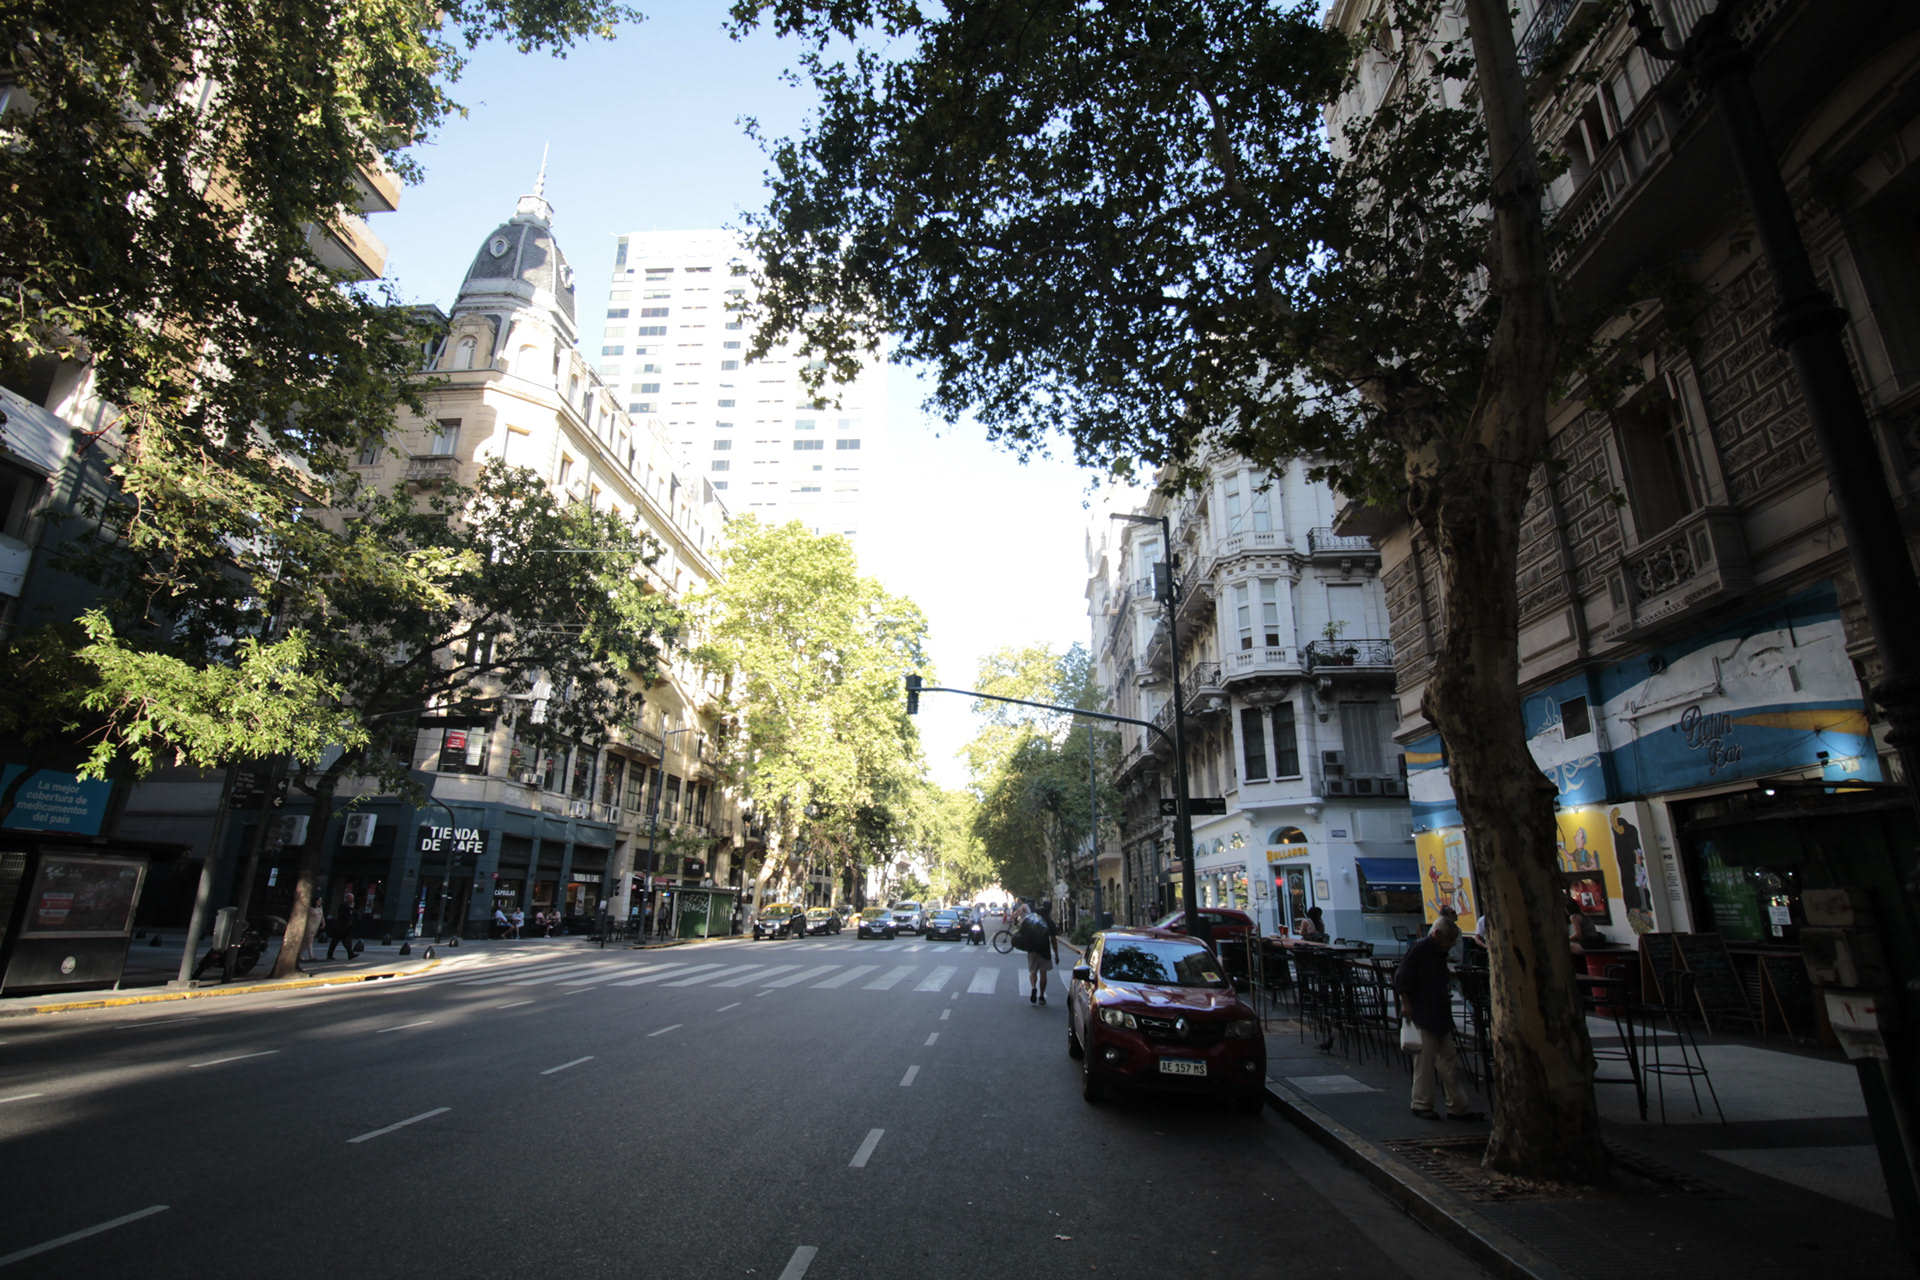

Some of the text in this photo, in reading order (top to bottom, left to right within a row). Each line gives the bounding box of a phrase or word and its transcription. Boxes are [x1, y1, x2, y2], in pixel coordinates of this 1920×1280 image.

[1709, 737, 1743, 776] Bar
[38, 780, 80, 795] La mejor
[26, 791, 88, 805] cobertura de
[16, 801, 88, 816] medicamentos
[32, 812, 71, 825] del país
[430, 826, 480, 841] TIENDA
[421, 838, 442, 851] DE
[573, 873, 586, 882] TIENDA
[1162, 1062, 1205, 1075] AE 157 MS
